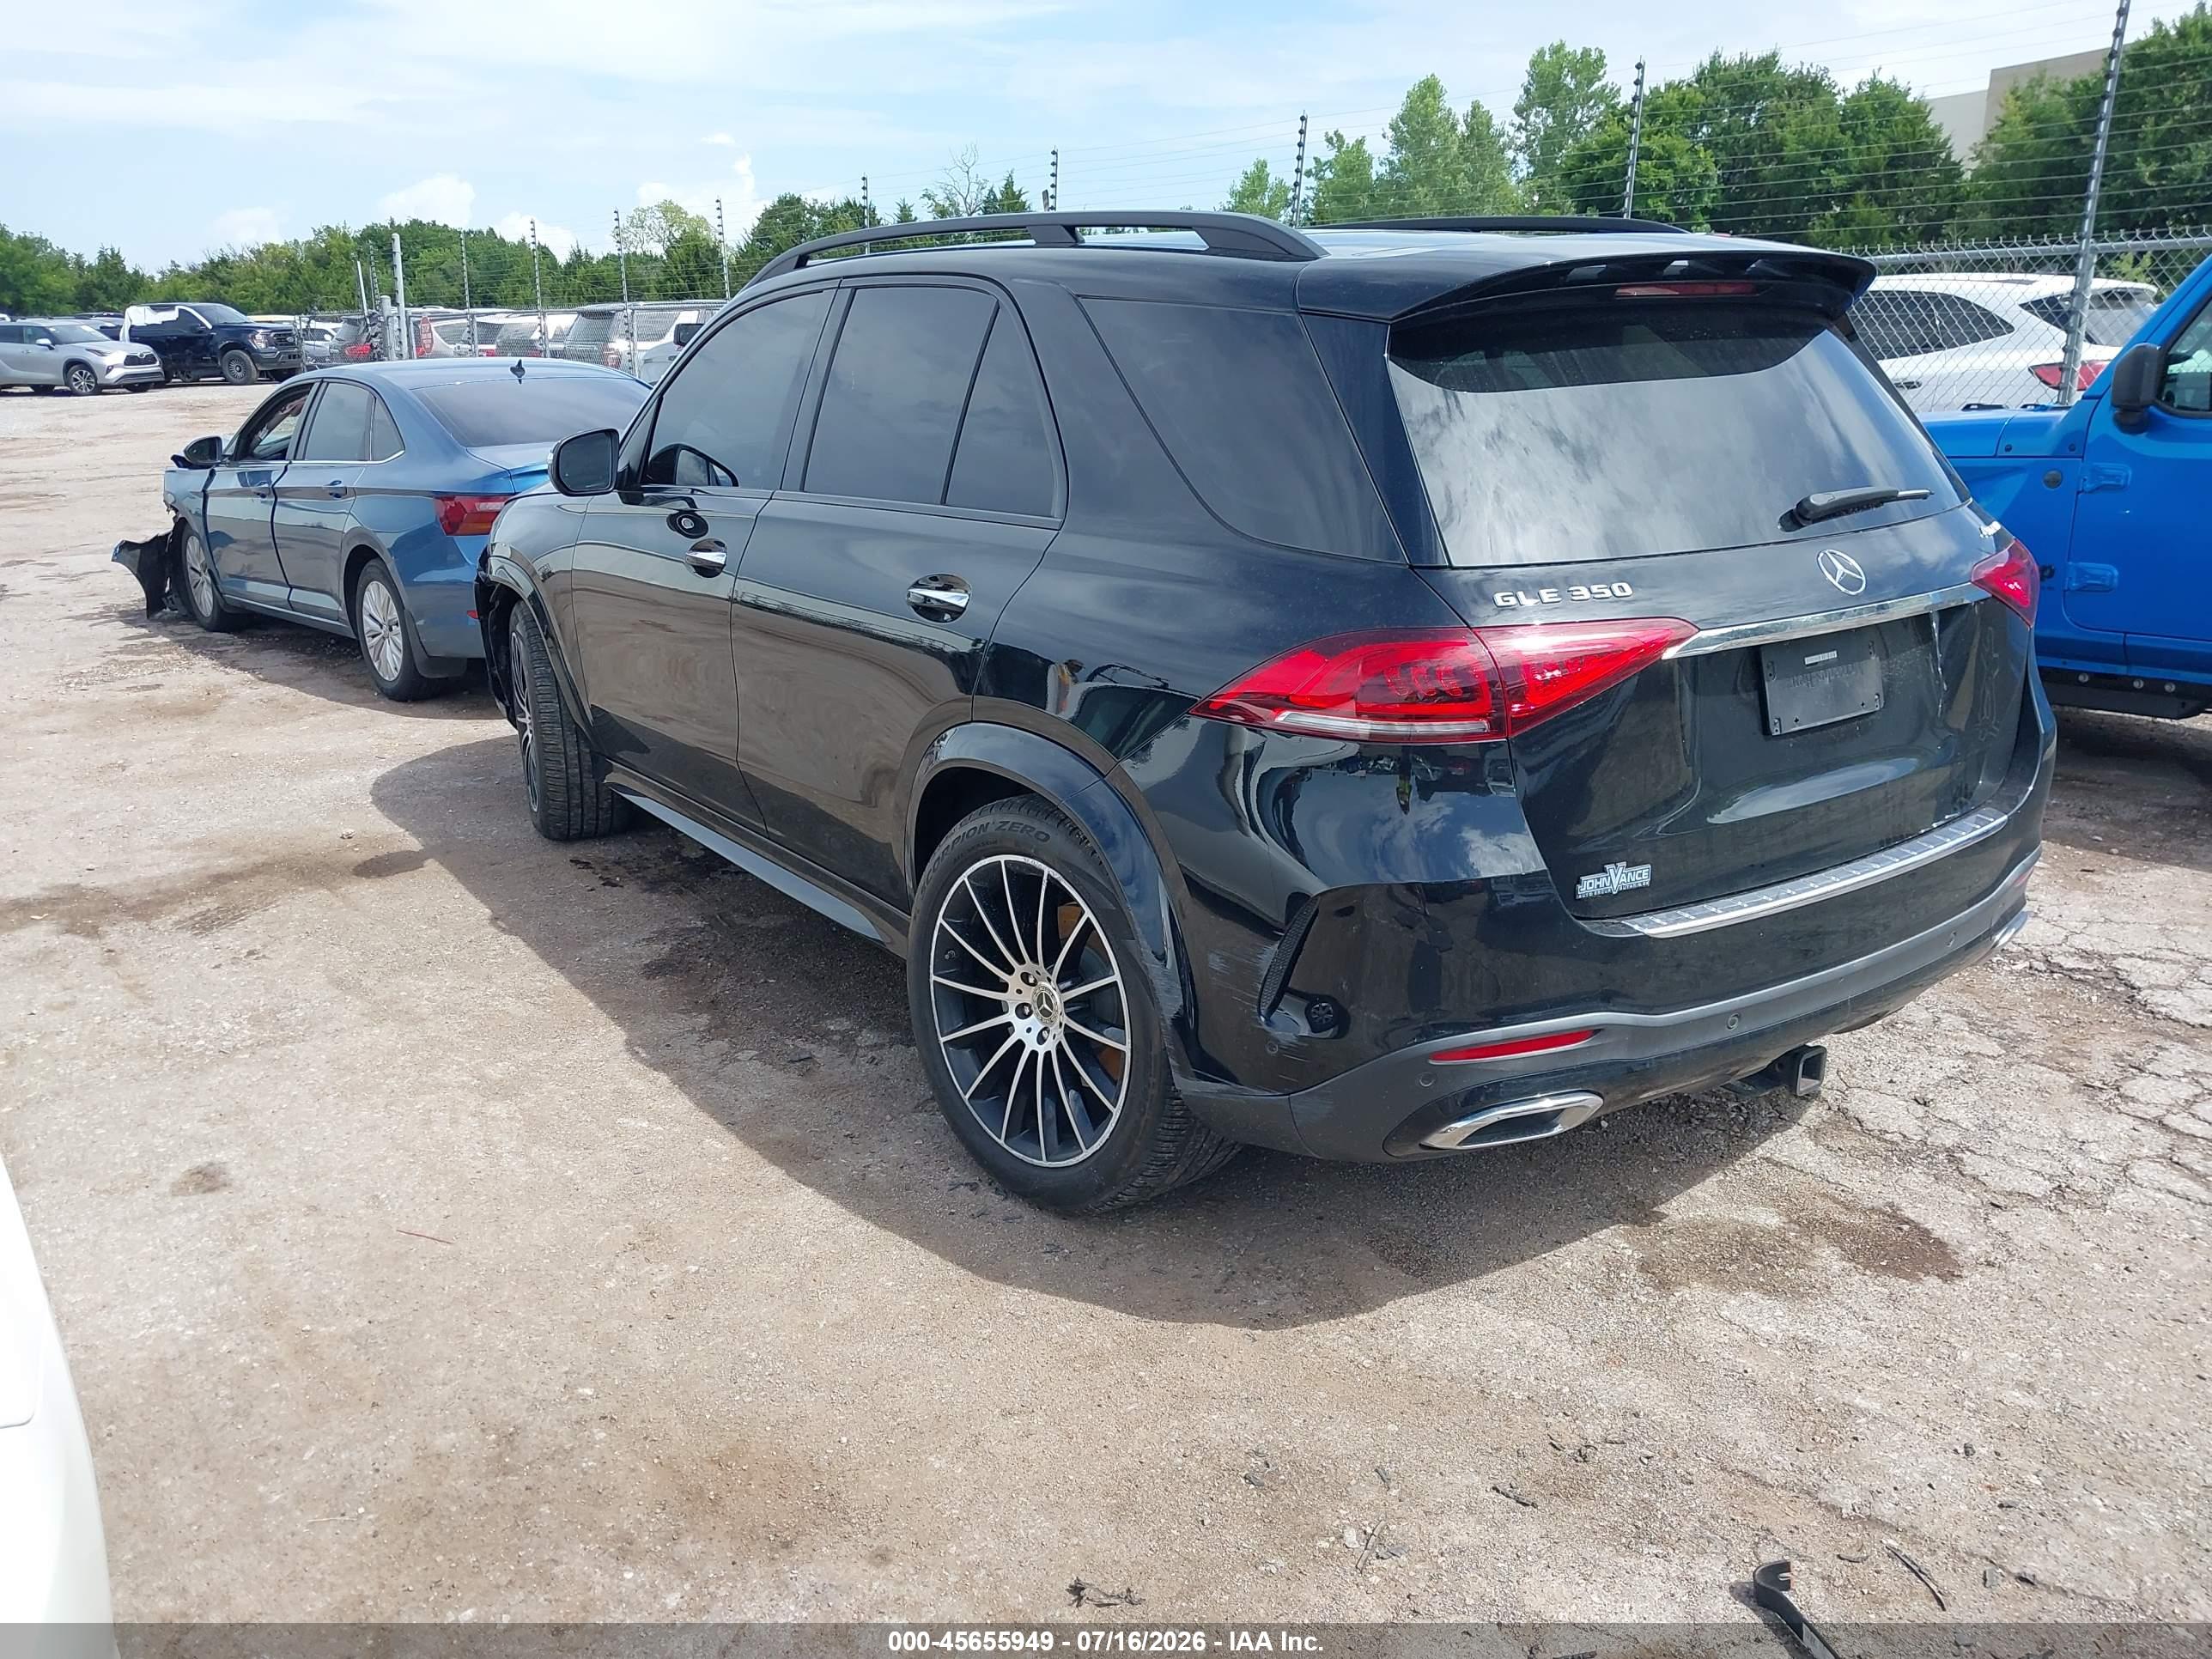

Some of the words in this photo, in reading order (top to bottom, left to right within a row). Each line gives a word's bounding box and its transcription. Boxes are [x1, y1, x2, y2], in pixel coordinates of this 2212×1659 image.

[1492, 588, 1562, 607] GLE
[1567, 581, 1633, 601] 350
[994, 820, 1051, 842] ZERO
